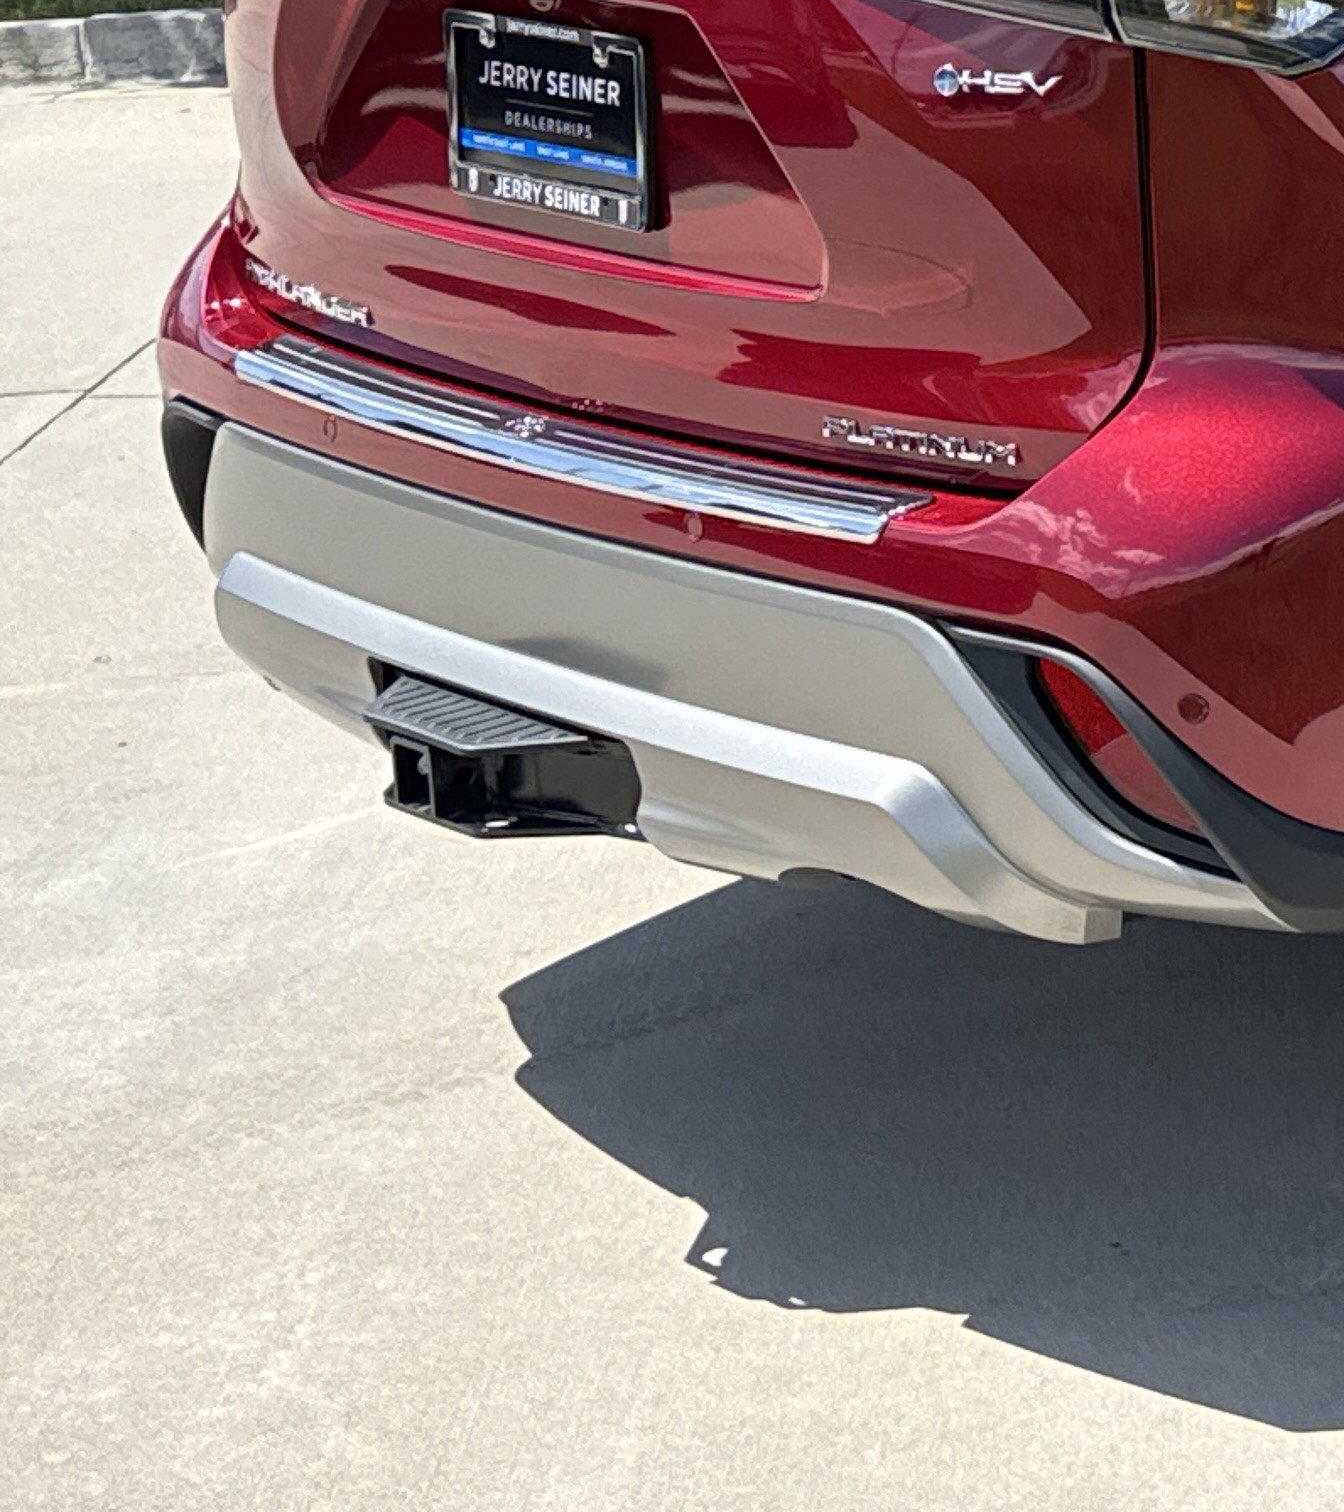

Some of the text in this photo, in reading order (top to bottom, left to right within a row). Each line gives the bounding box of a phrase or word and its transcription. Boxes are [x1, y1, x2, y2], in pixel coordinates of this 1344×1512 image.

[478, 60, 621, 107] JERRY SEINER
[504, 110, 593, 140] DEALERSHIPS
[493, 176, 600, 217] JERRY SEINER
[821, 415, 1022, 467] PLATINUM
